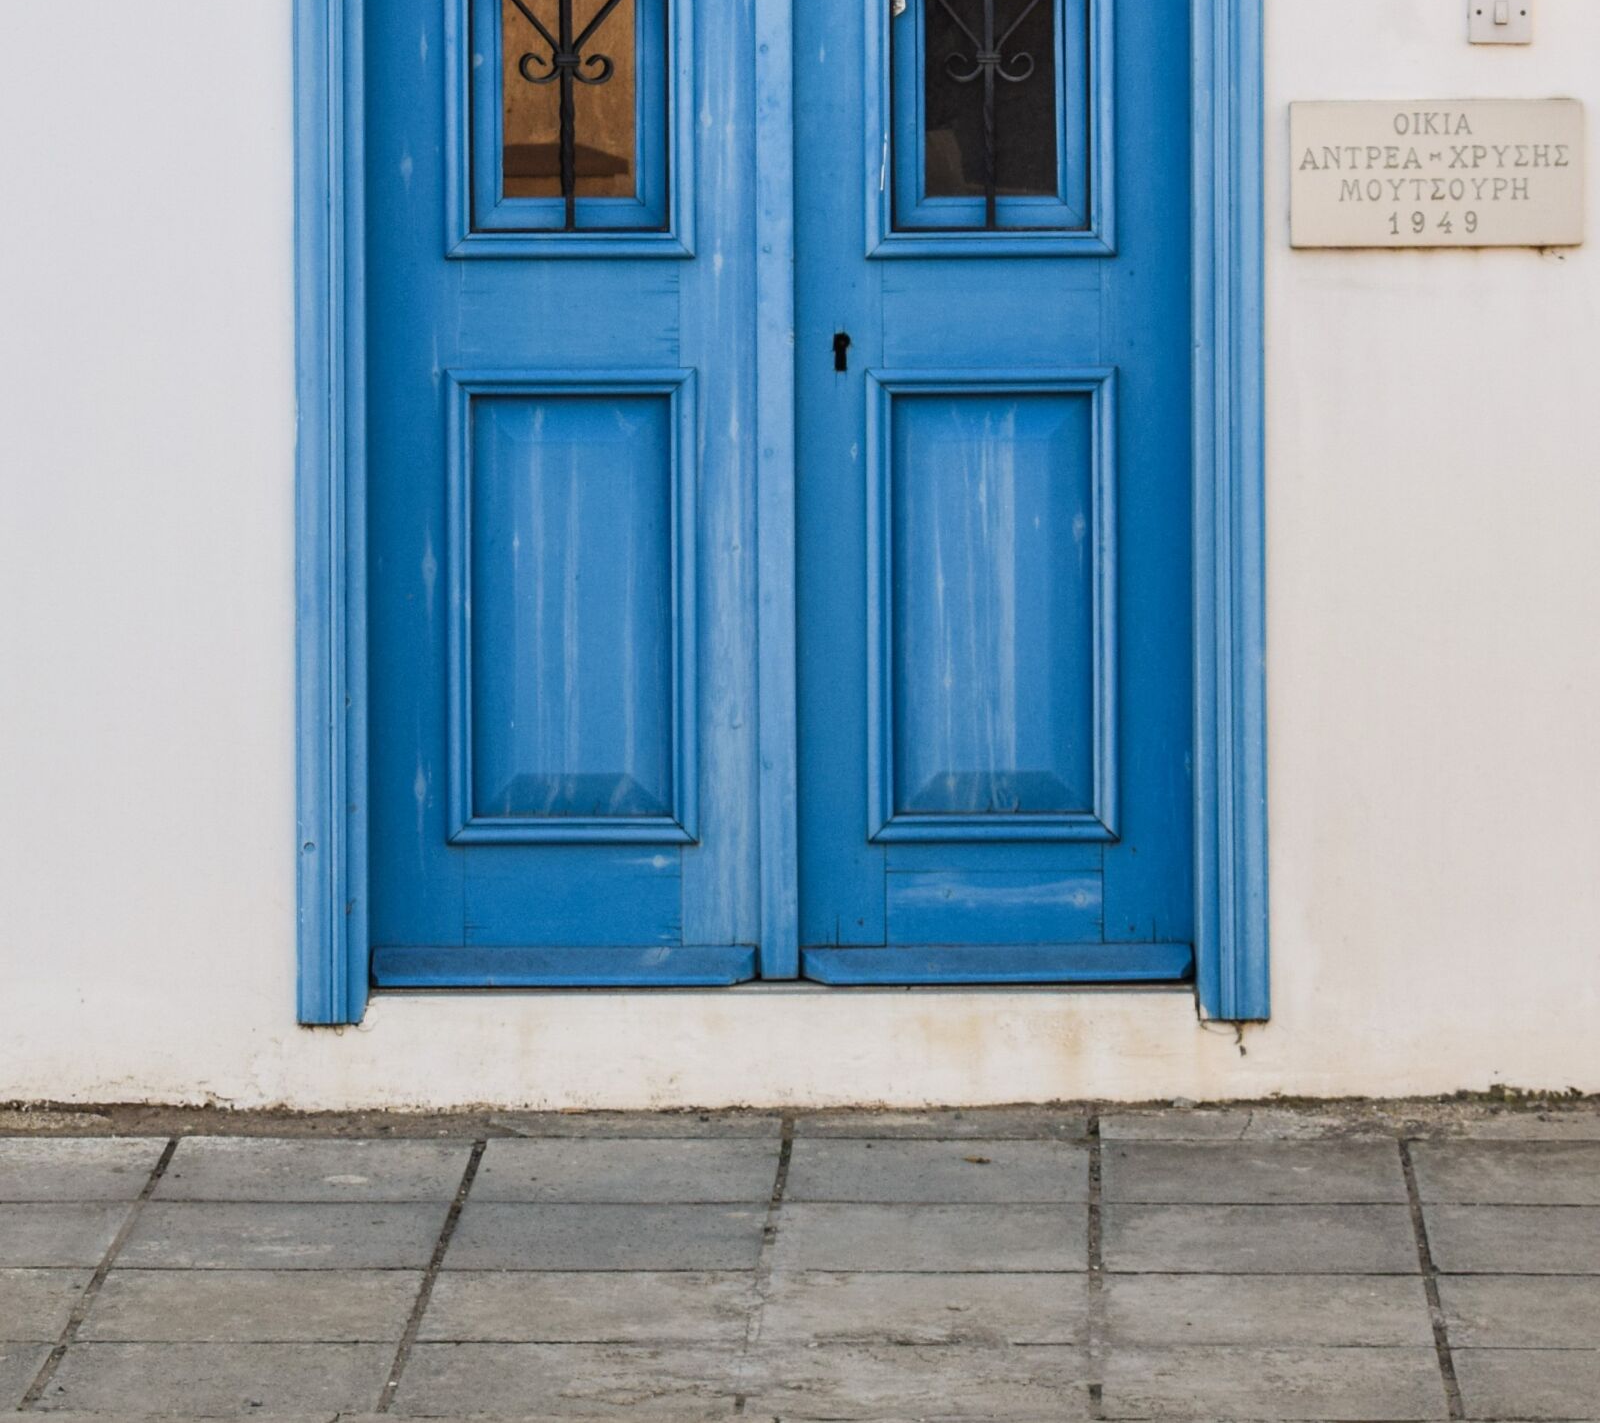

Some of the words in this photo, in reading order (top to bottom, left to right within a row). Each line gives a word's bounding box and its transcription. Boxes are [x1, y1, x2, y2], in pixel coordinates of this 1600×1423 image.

[1393, 112, 1473, 136] ΟΙΚΙΑ
[1338, 177, 1530, 202] ΜΟΥΤΣΟΥΡΗ
[1388, 210, 1479, 235] 1949
